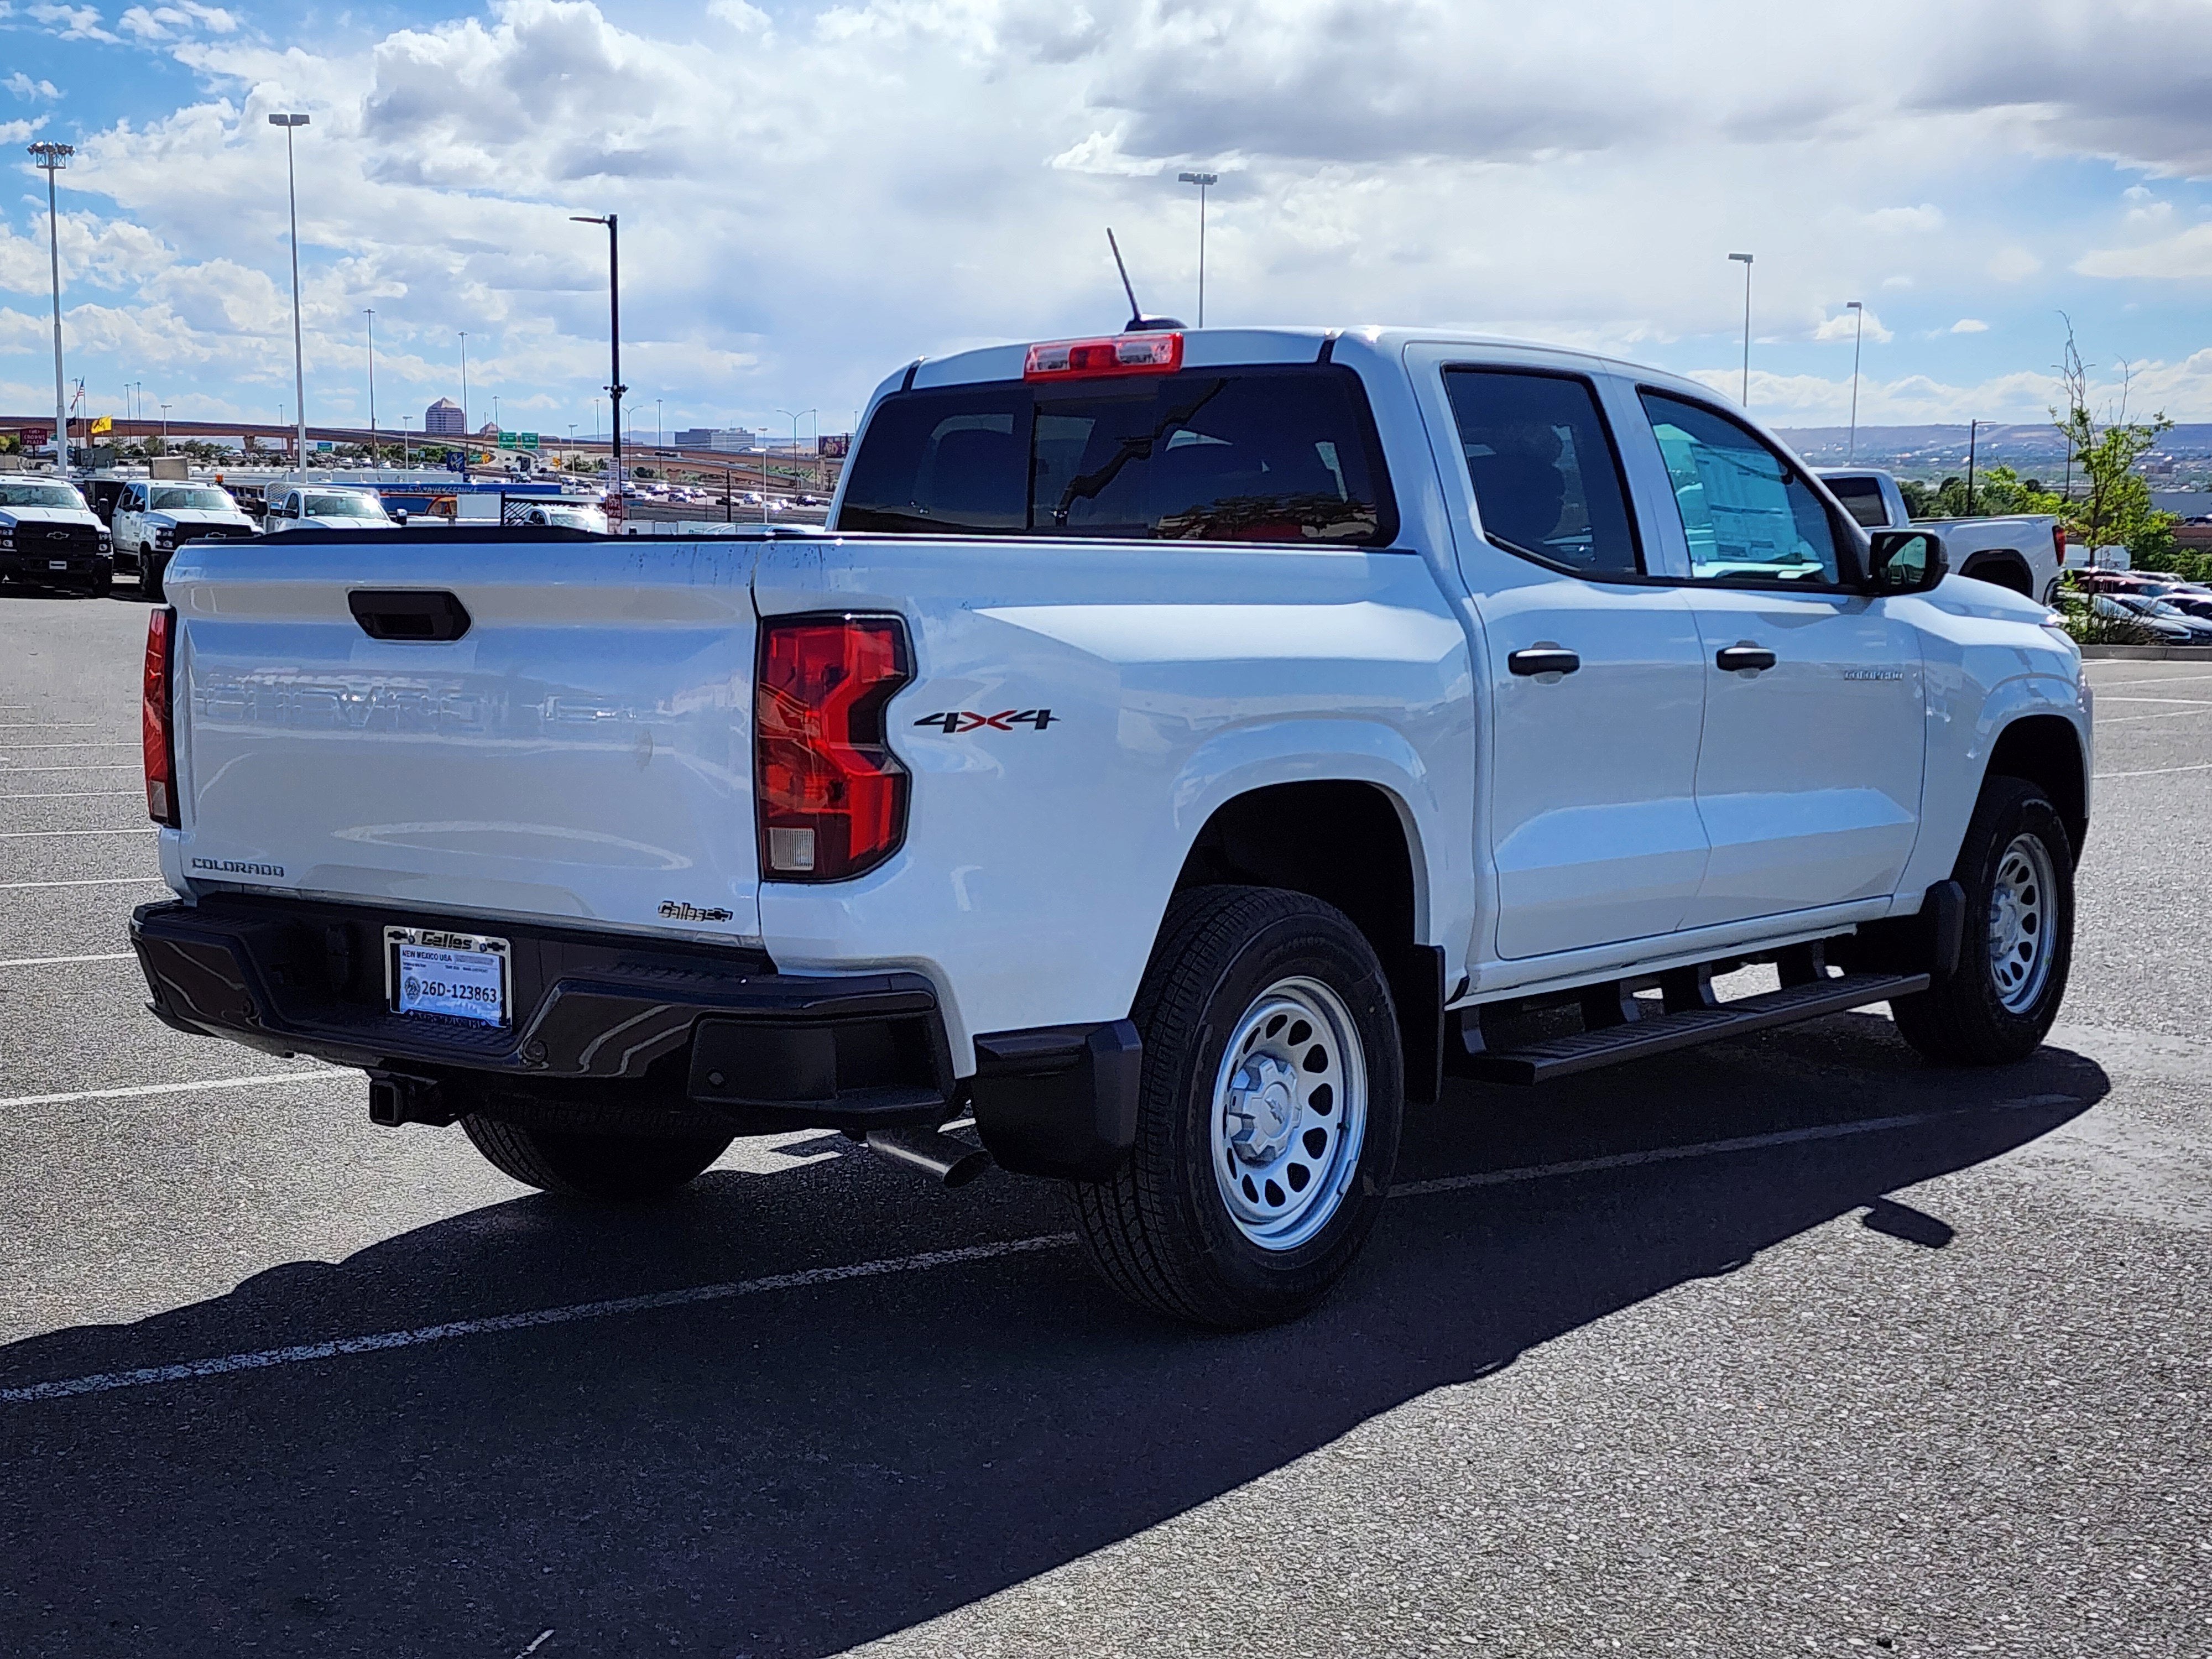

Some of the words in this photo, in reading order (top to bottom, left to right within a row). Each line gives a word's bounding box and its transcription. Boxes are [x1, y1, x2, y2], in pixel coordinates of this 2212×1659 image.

[192, 858, 284, 877] COLORADO
[421, 931, 472, 950] Galles
[417, 952, 439, 961] MEXICO
[422, 981, 497, 1003] 26D-123863
